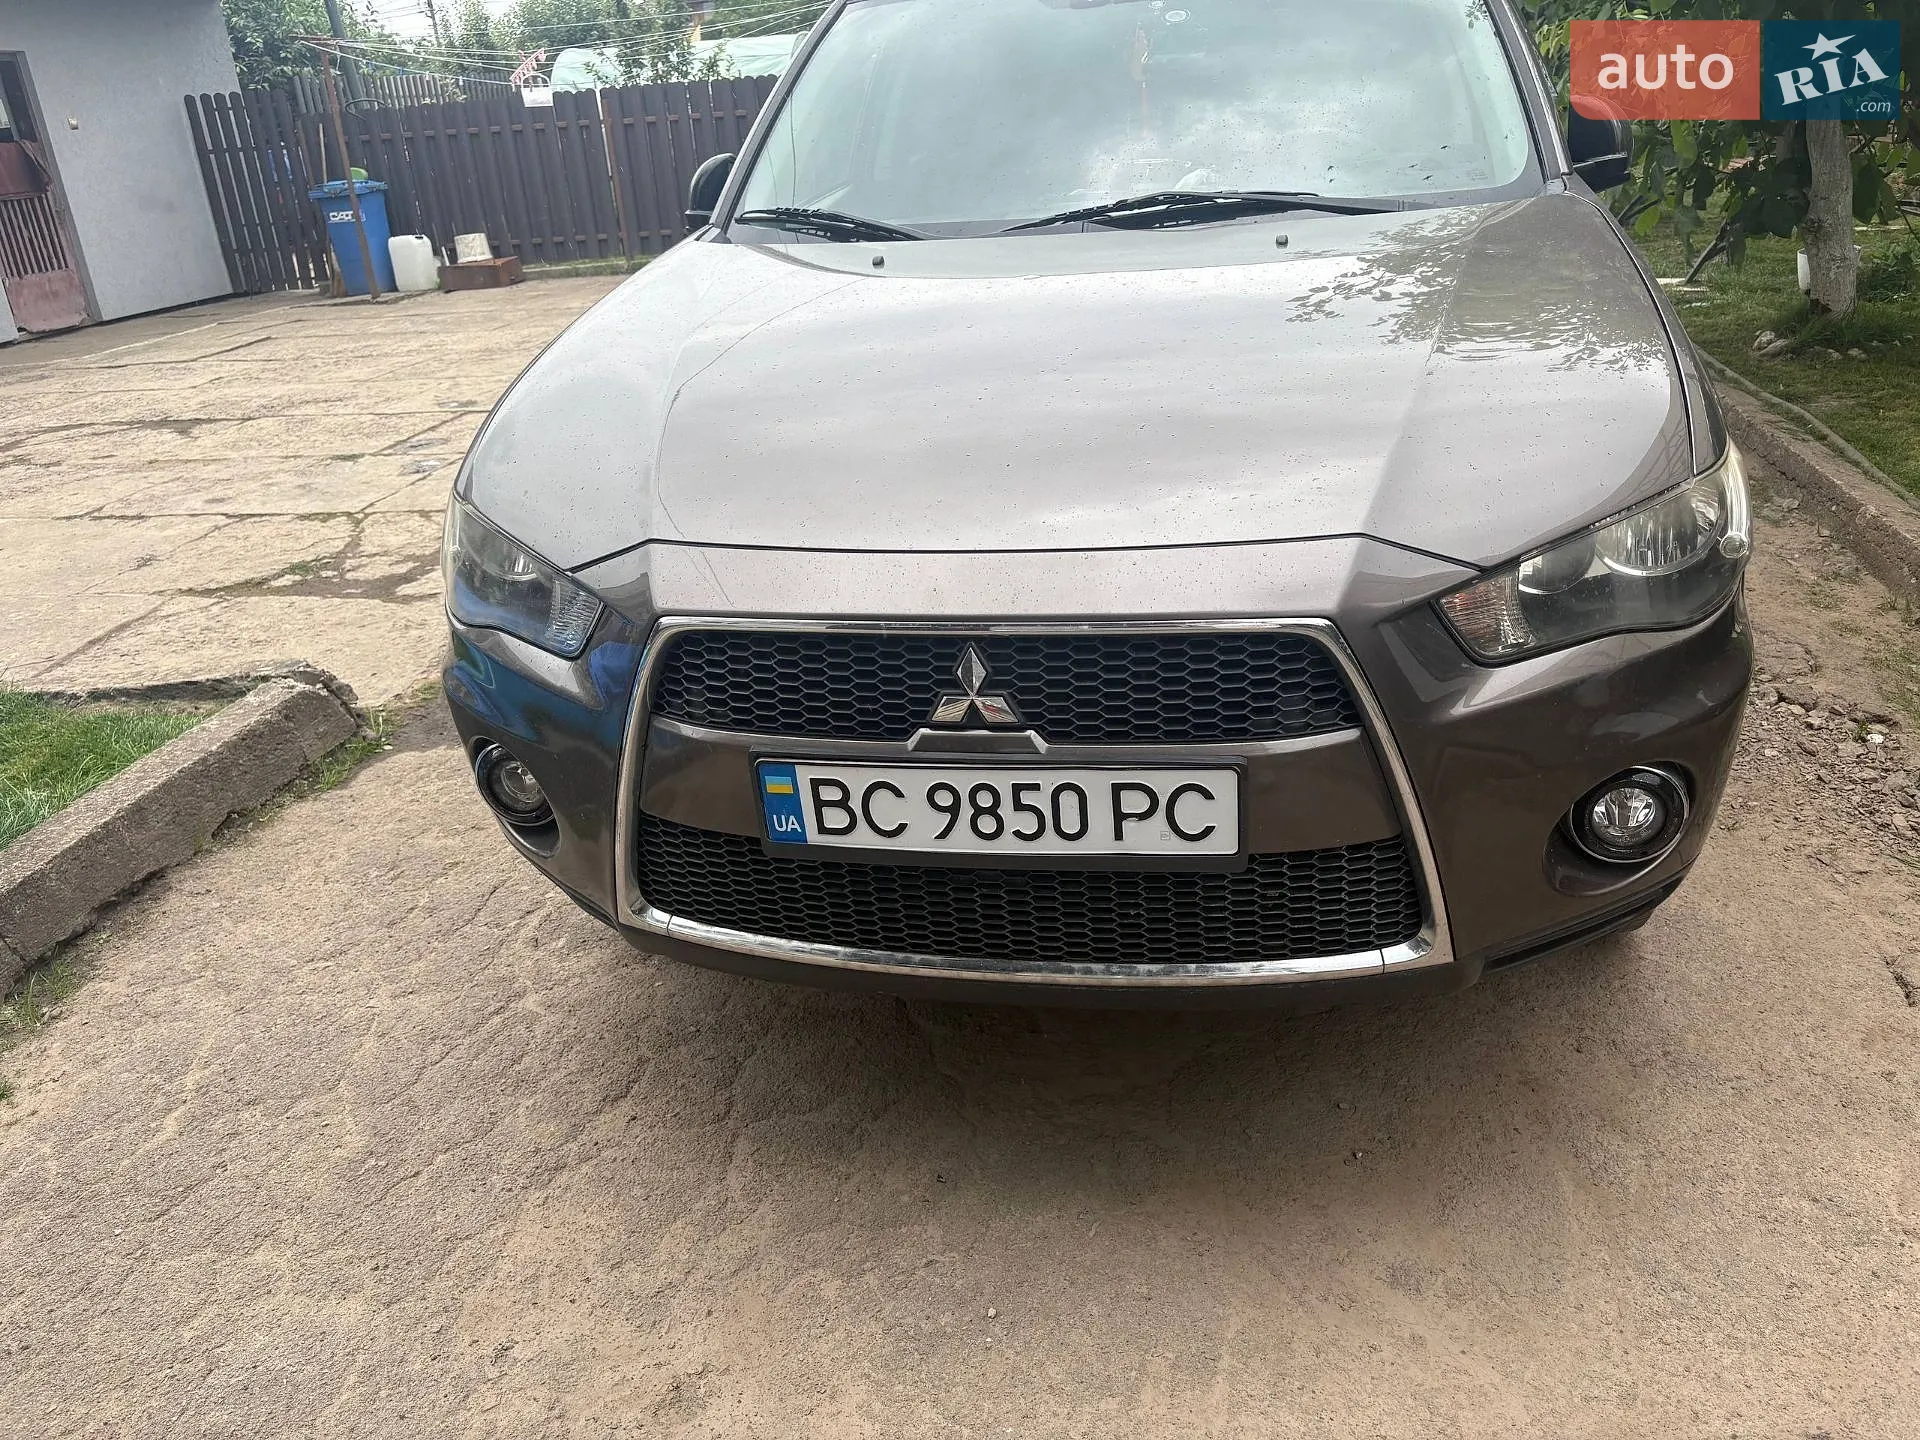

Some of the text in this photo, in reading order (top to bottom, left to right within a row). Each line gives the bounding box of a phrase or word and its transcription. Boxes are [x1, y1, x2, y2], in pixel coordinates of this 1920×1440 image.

[773, 815, 801, 832] UA
[809, 777, 1216, 842] BC 9850 PC
